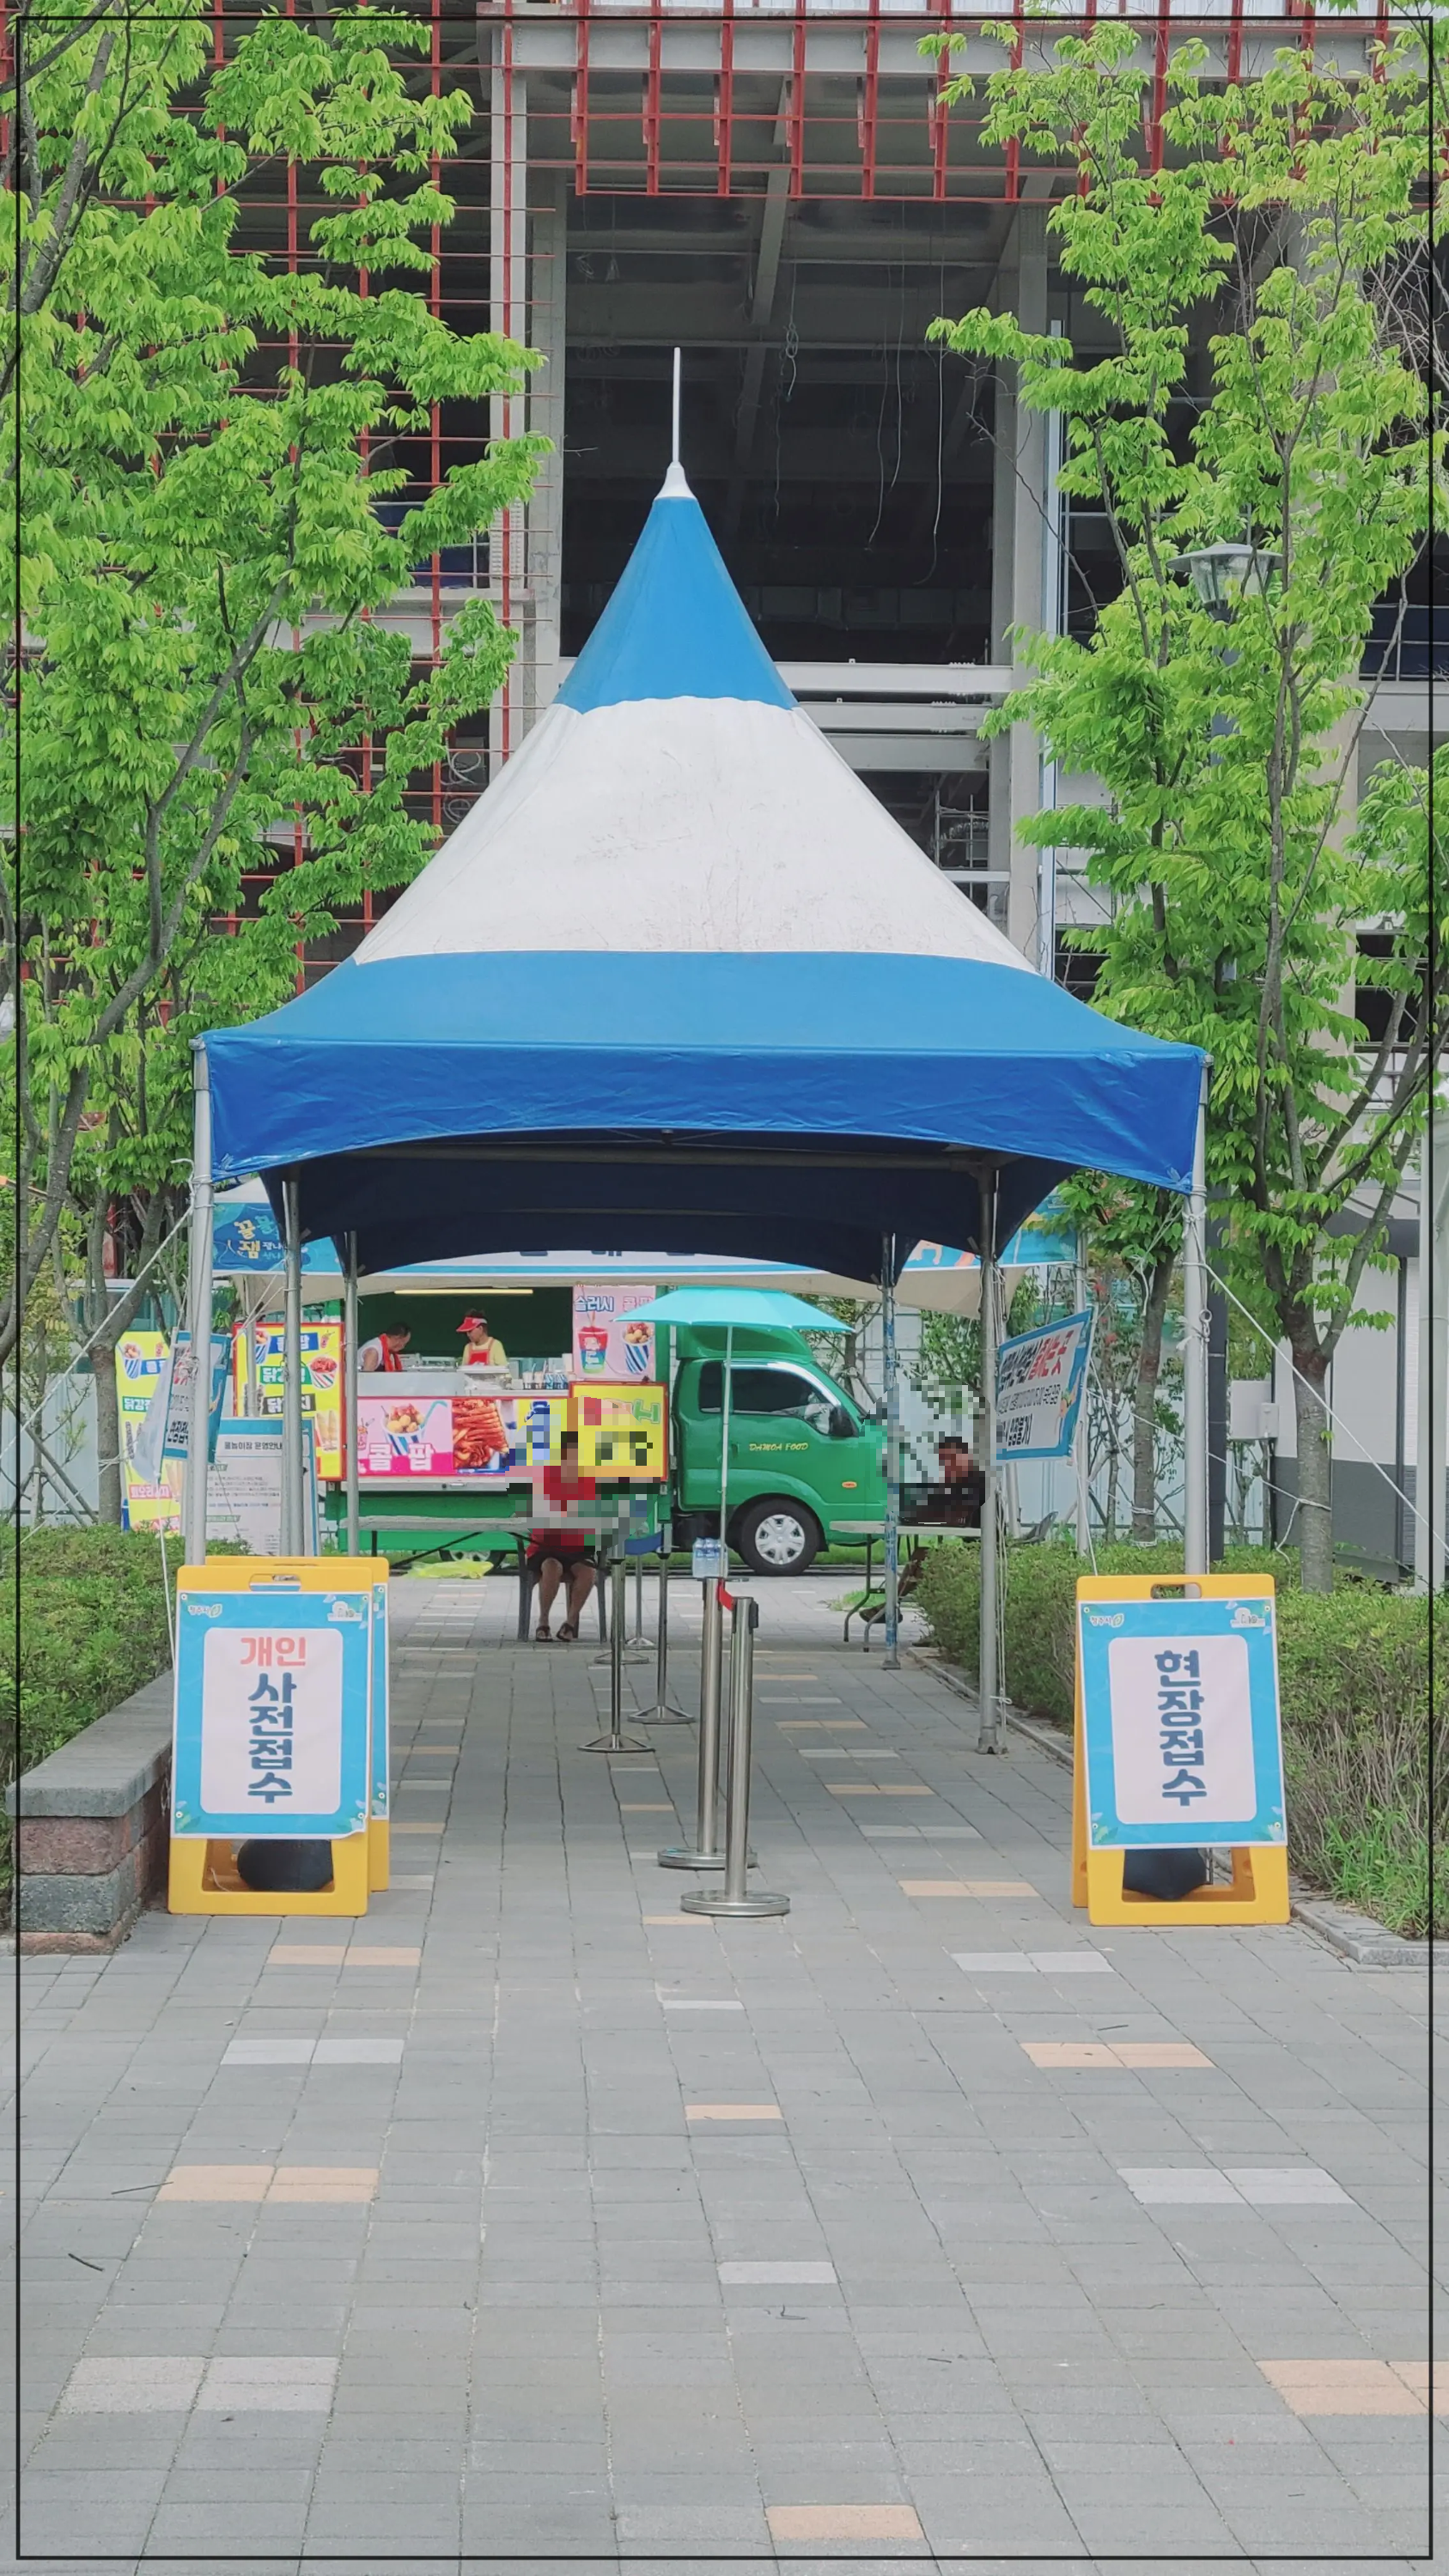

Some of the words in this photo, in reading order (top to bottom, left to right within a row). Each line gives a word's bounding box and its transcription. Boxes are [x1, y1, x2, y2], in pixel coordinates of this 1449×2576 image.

[575, 1295, 615, 1312] 슬러시
[785, 1443, 808, 1451] FOOD
[240, 1636, 306, 1667] 개인
[247, 1672, 297, 1804] 사전접수
[1154, 1649, 1207, 1807] 현장접수
